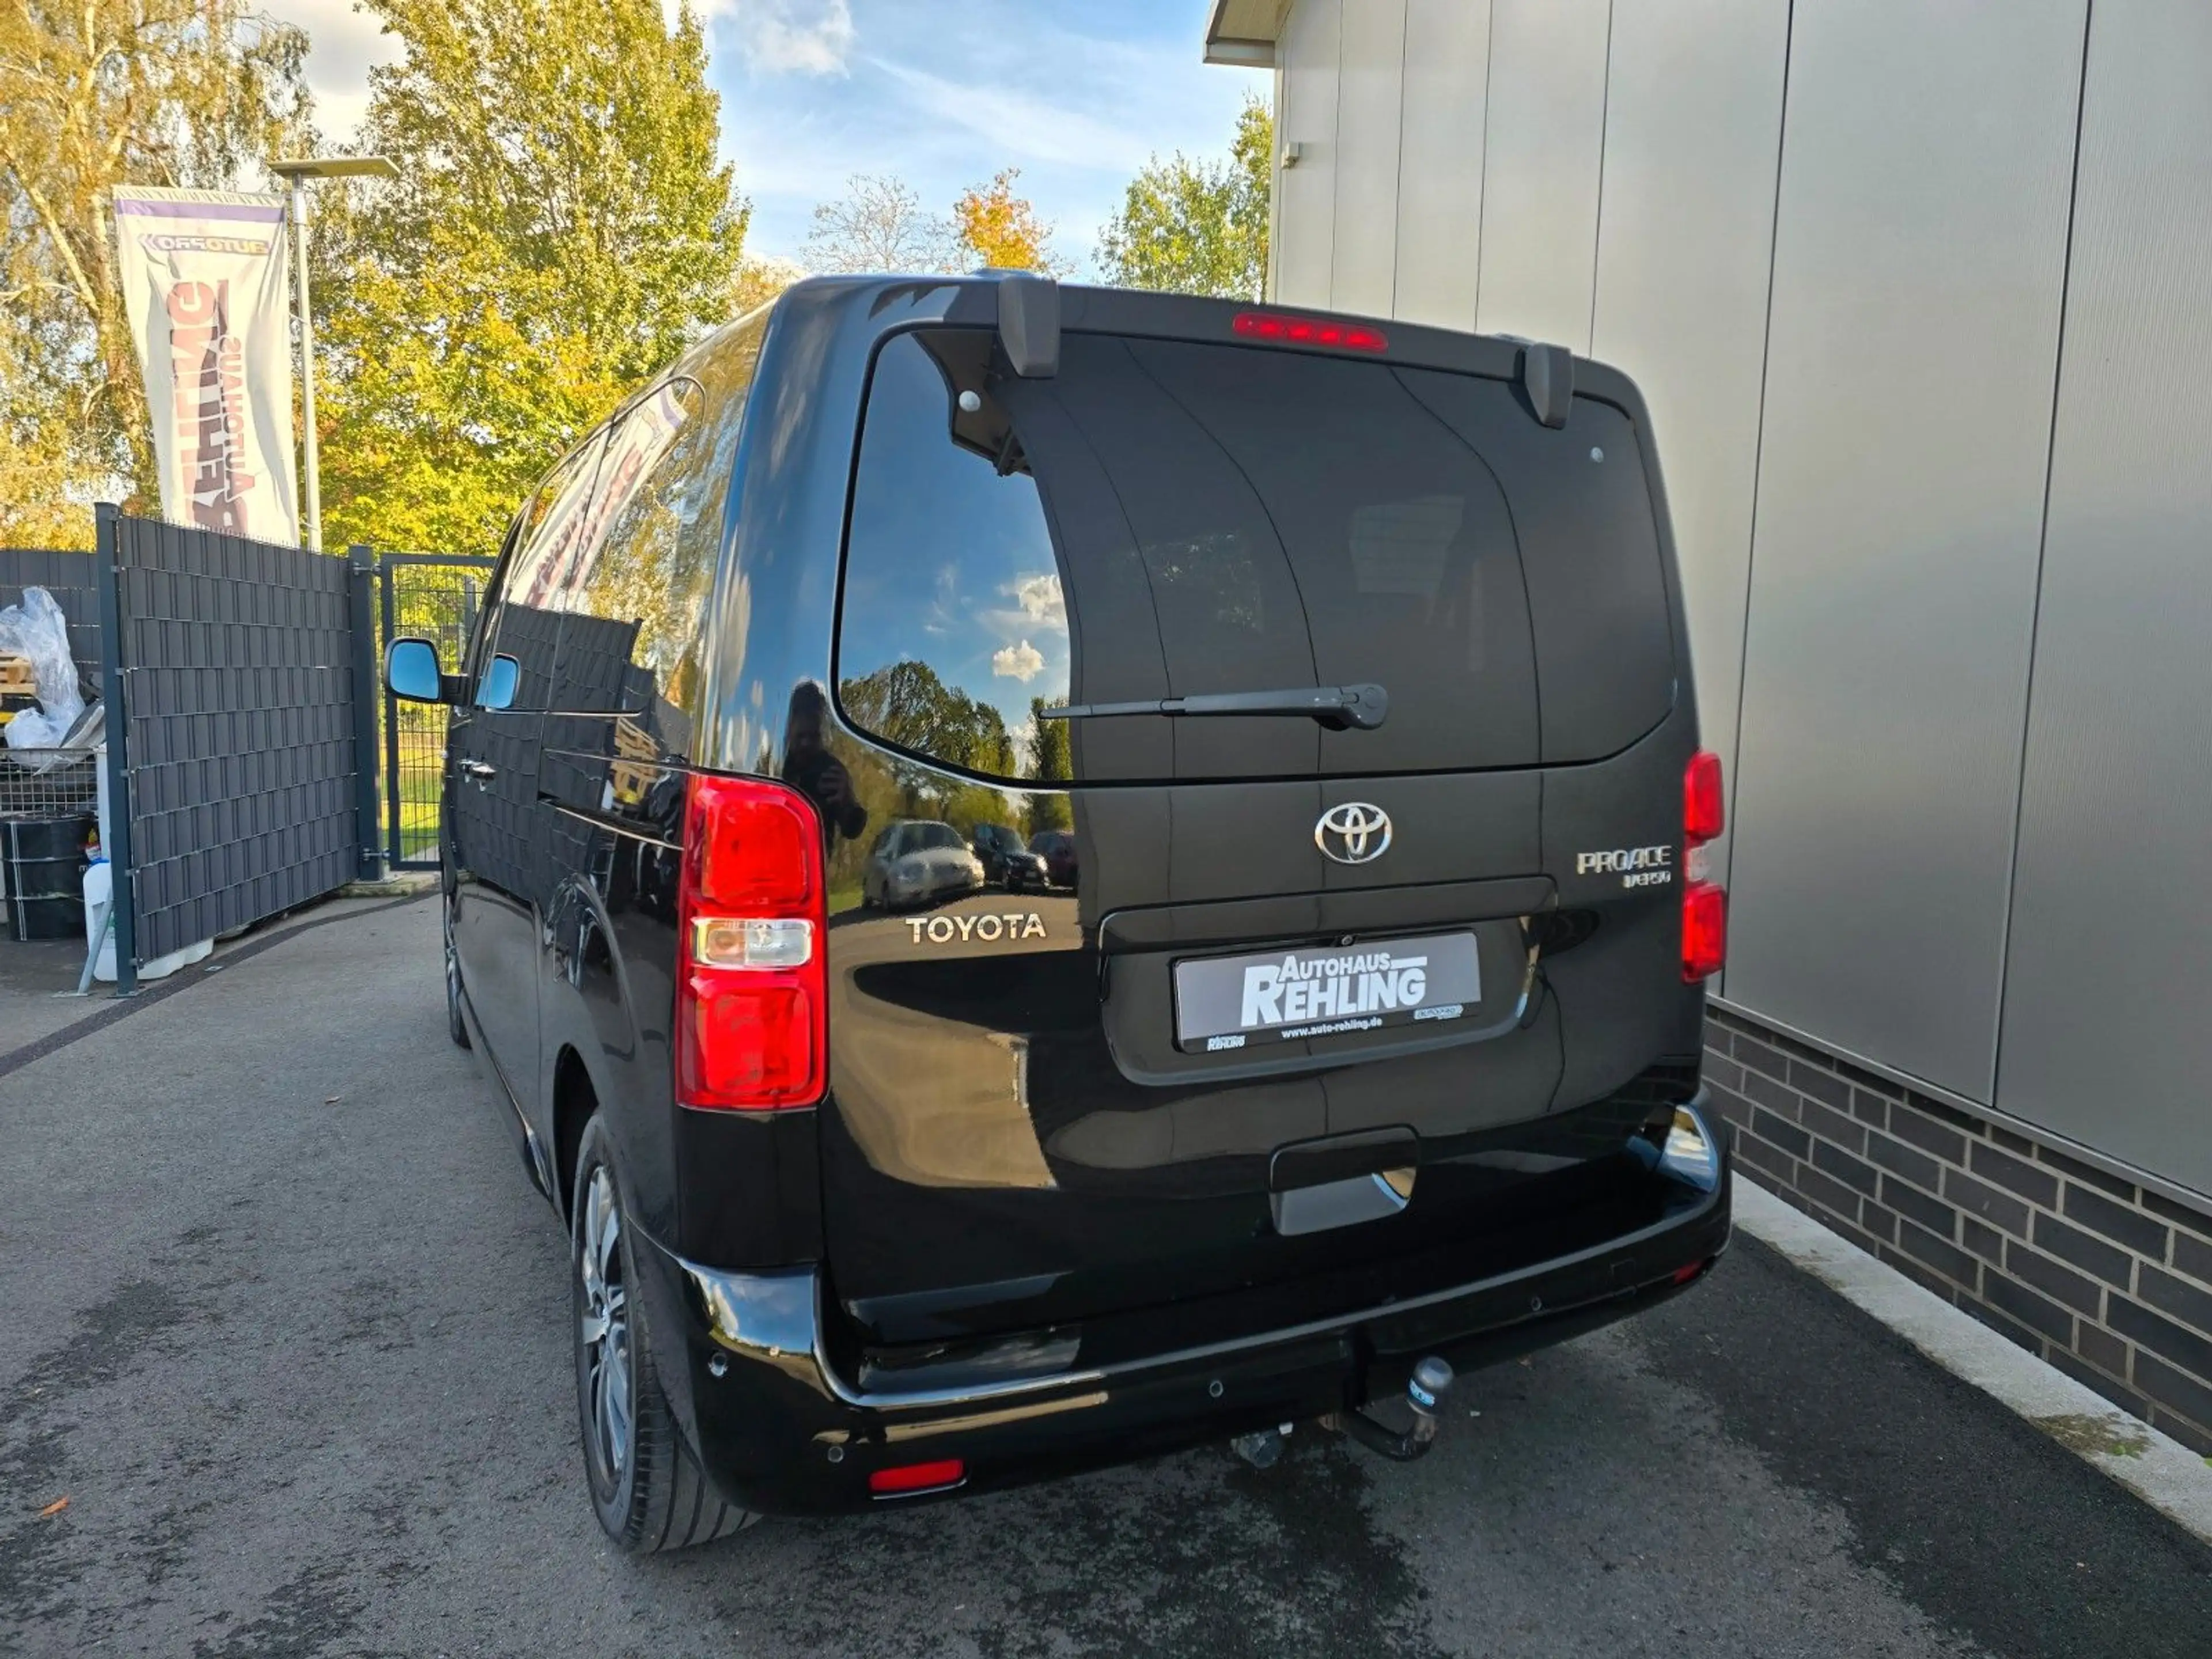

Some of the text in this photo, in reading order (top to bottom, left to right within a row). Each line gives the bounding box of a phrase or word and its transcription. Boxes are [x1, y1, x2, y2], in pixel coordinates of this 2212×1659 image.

[1577, 845, 1672, 874] PROACE
[906, 914, 1046, 944] TOYOTA
[1278, 952, 1391, 983] AUTOHAUS
[1241, 964, 1426, 1027] REHLING
[1281, 1017, 1383, 1039] www.auto-rehling.de
